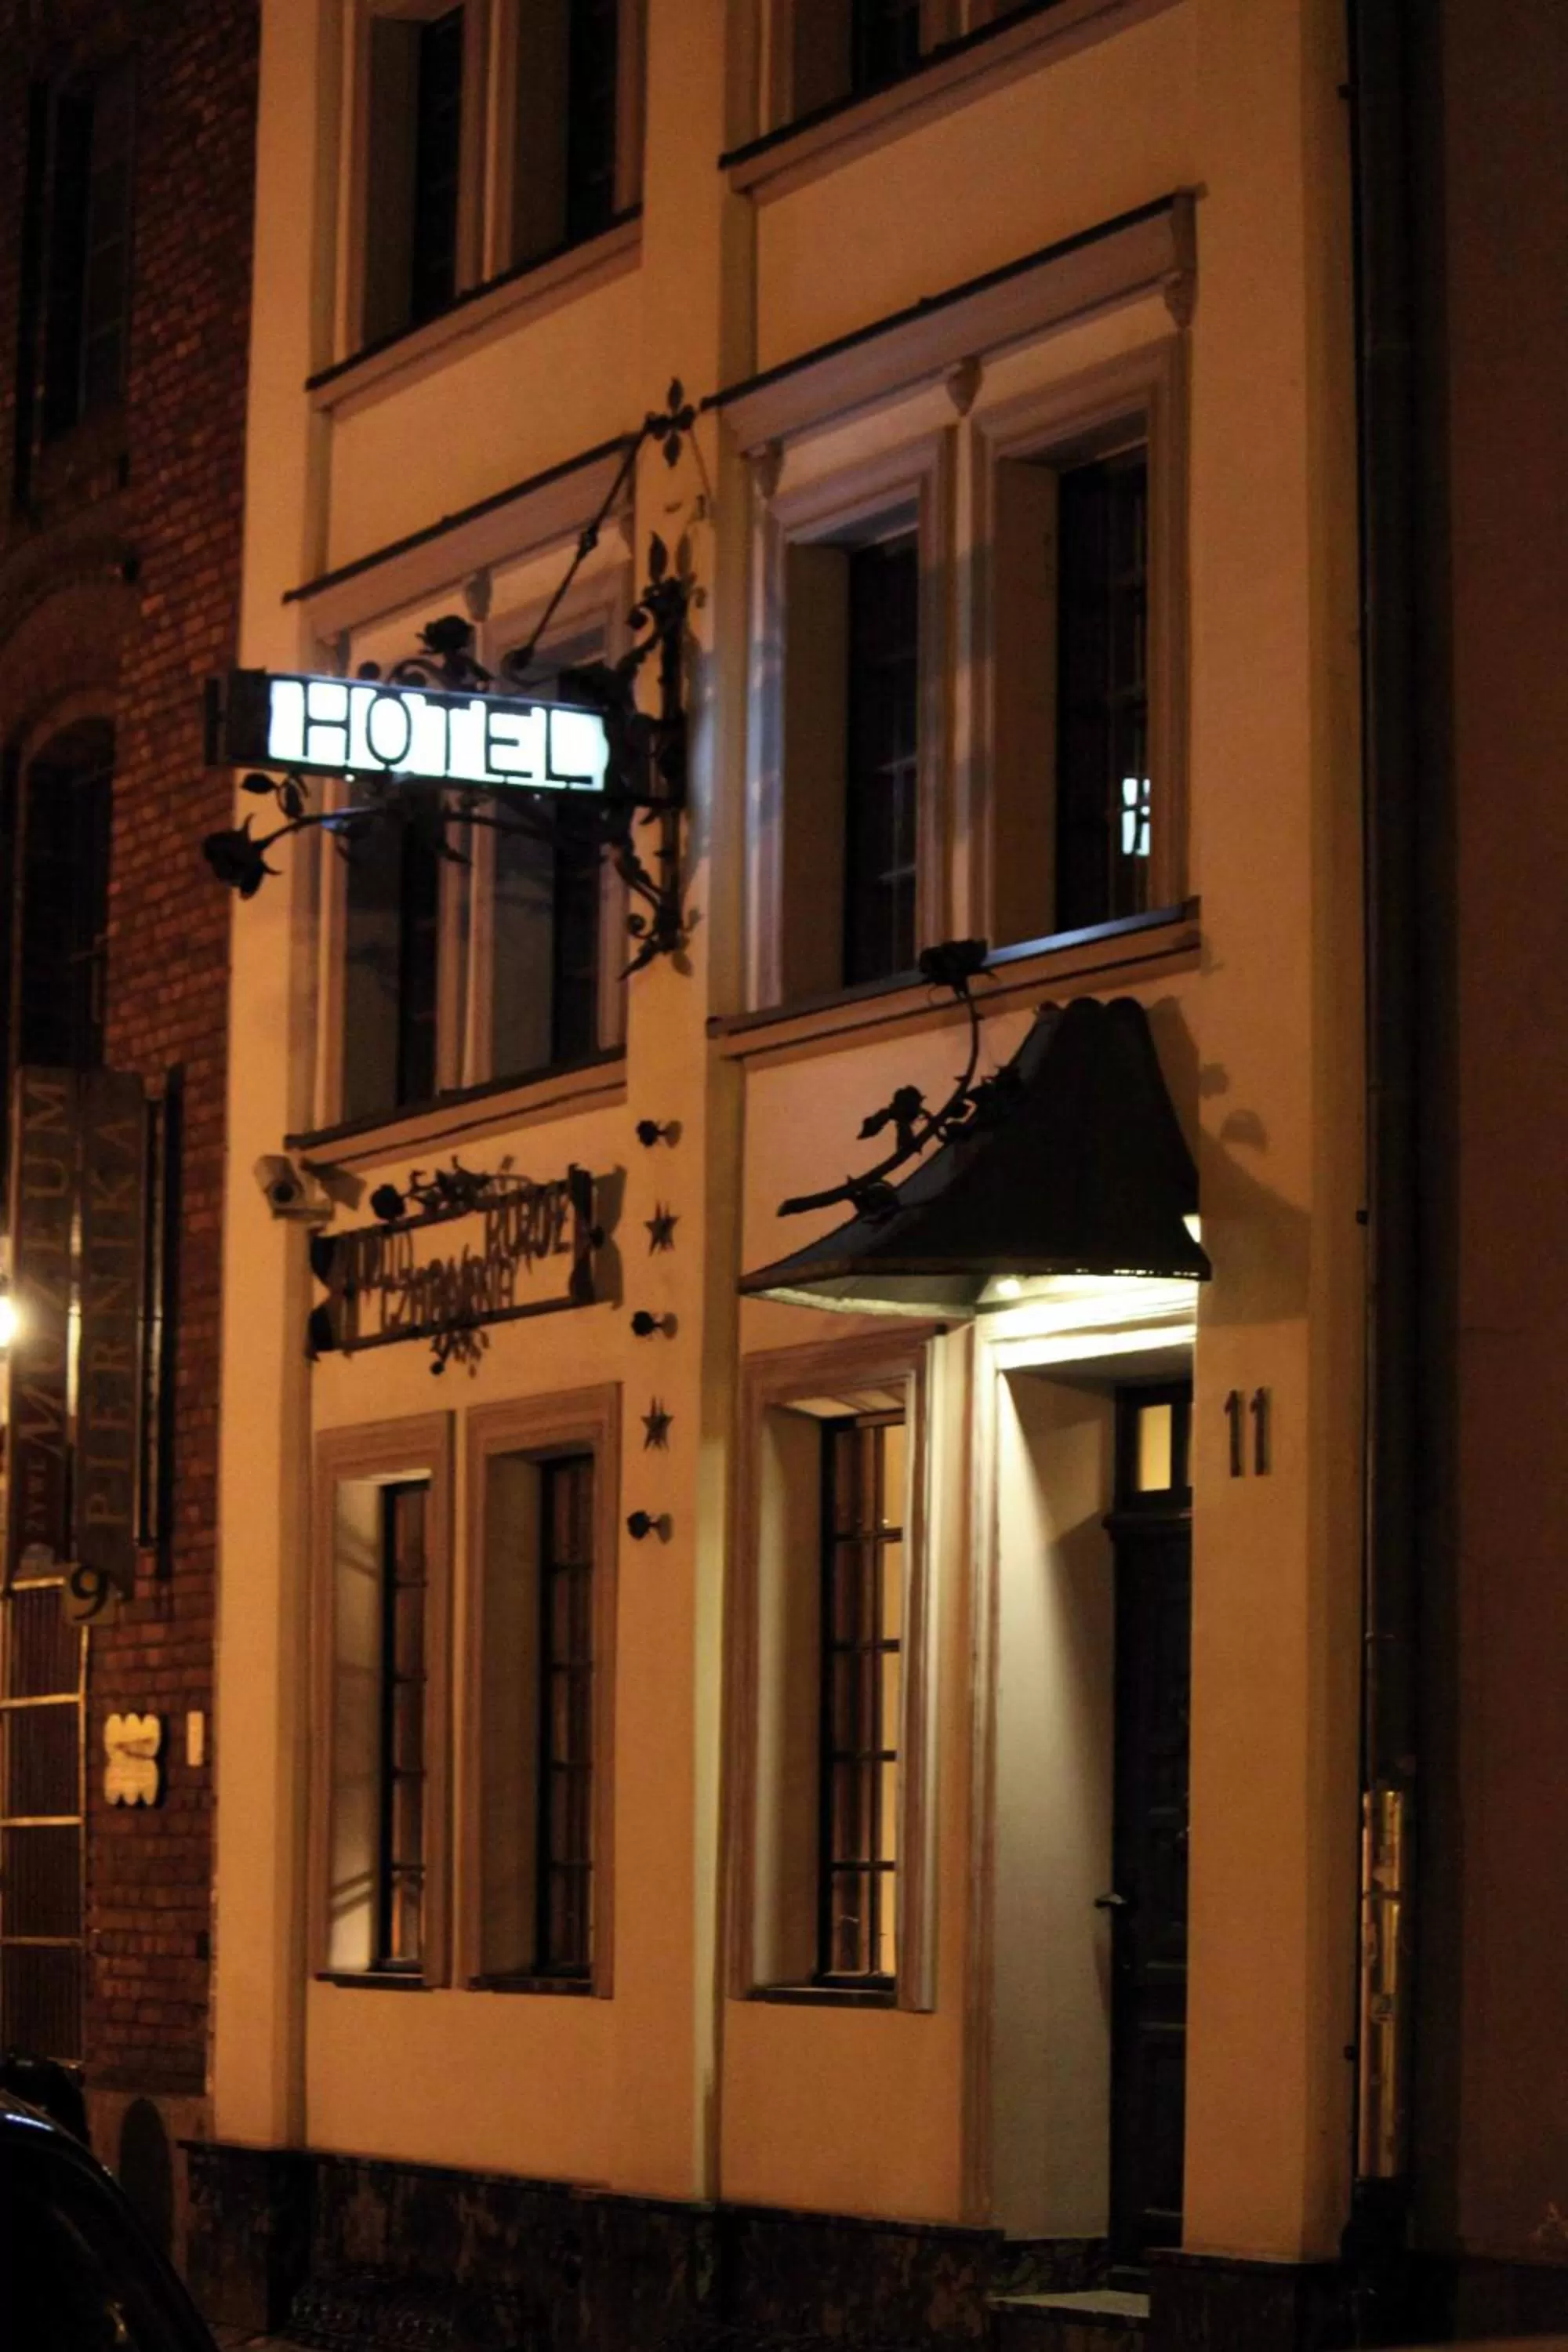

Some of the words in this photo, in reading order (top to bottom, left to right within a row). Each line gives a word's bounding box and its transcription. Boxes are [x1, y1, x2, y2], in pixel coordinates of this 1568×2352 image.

[303, 681, 593, 785] HOTEL
[84, 1116, 138, 1526] PIERNIKA
[1224, 1385, 1269, 1478] 11
[71, 1567, 110, 1621] 9
